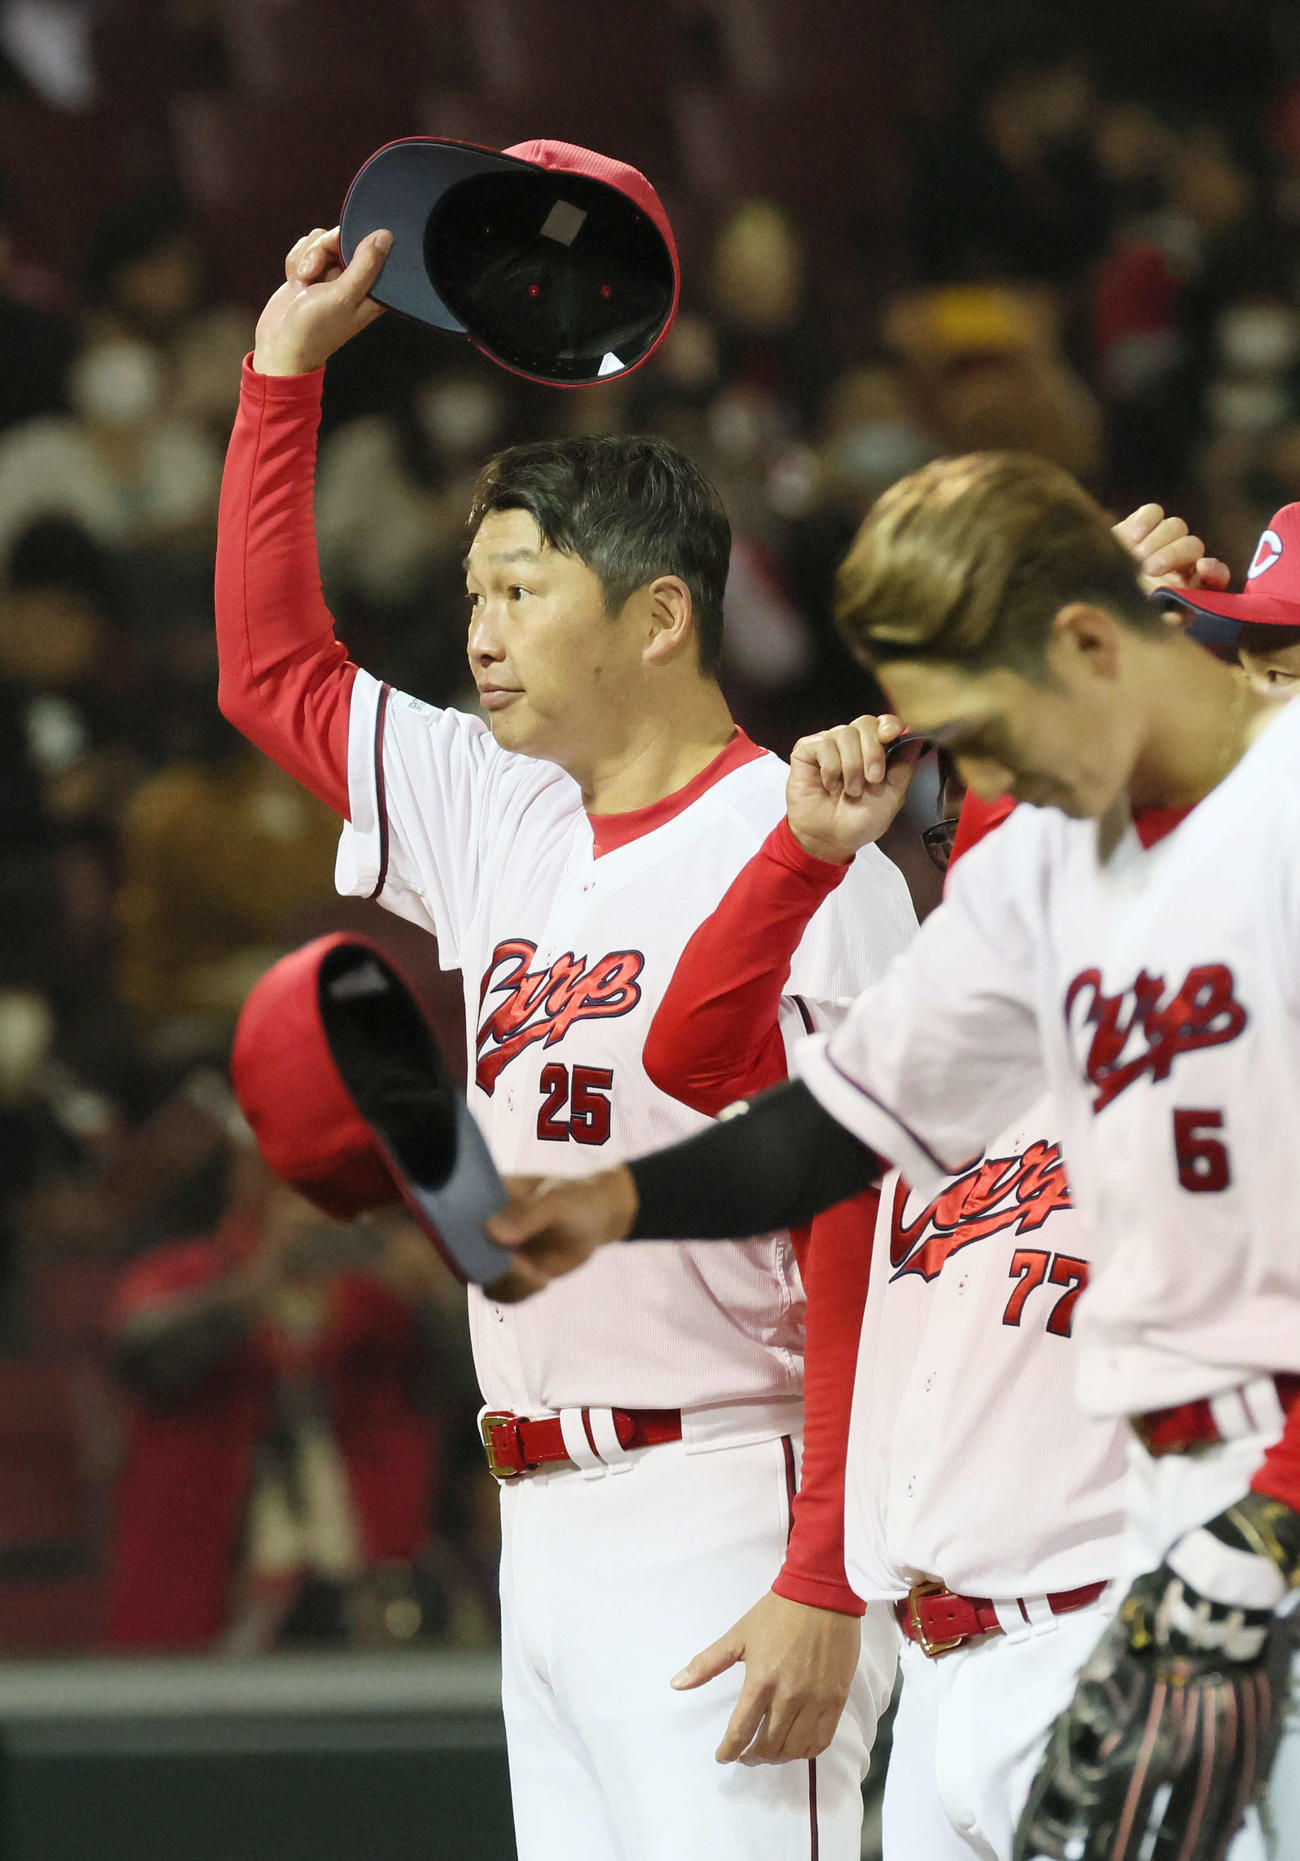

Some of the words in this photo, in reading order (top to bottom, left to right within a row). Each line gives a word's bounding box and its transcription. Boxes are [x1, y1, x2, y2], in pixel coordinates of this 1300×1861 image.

[1247, 529, 1283, 579] C
[475, 938, 645, 1098] Carp
[537, 1062, 614, 1146] 25
[1002, 1248, 1089, 1338] 77
